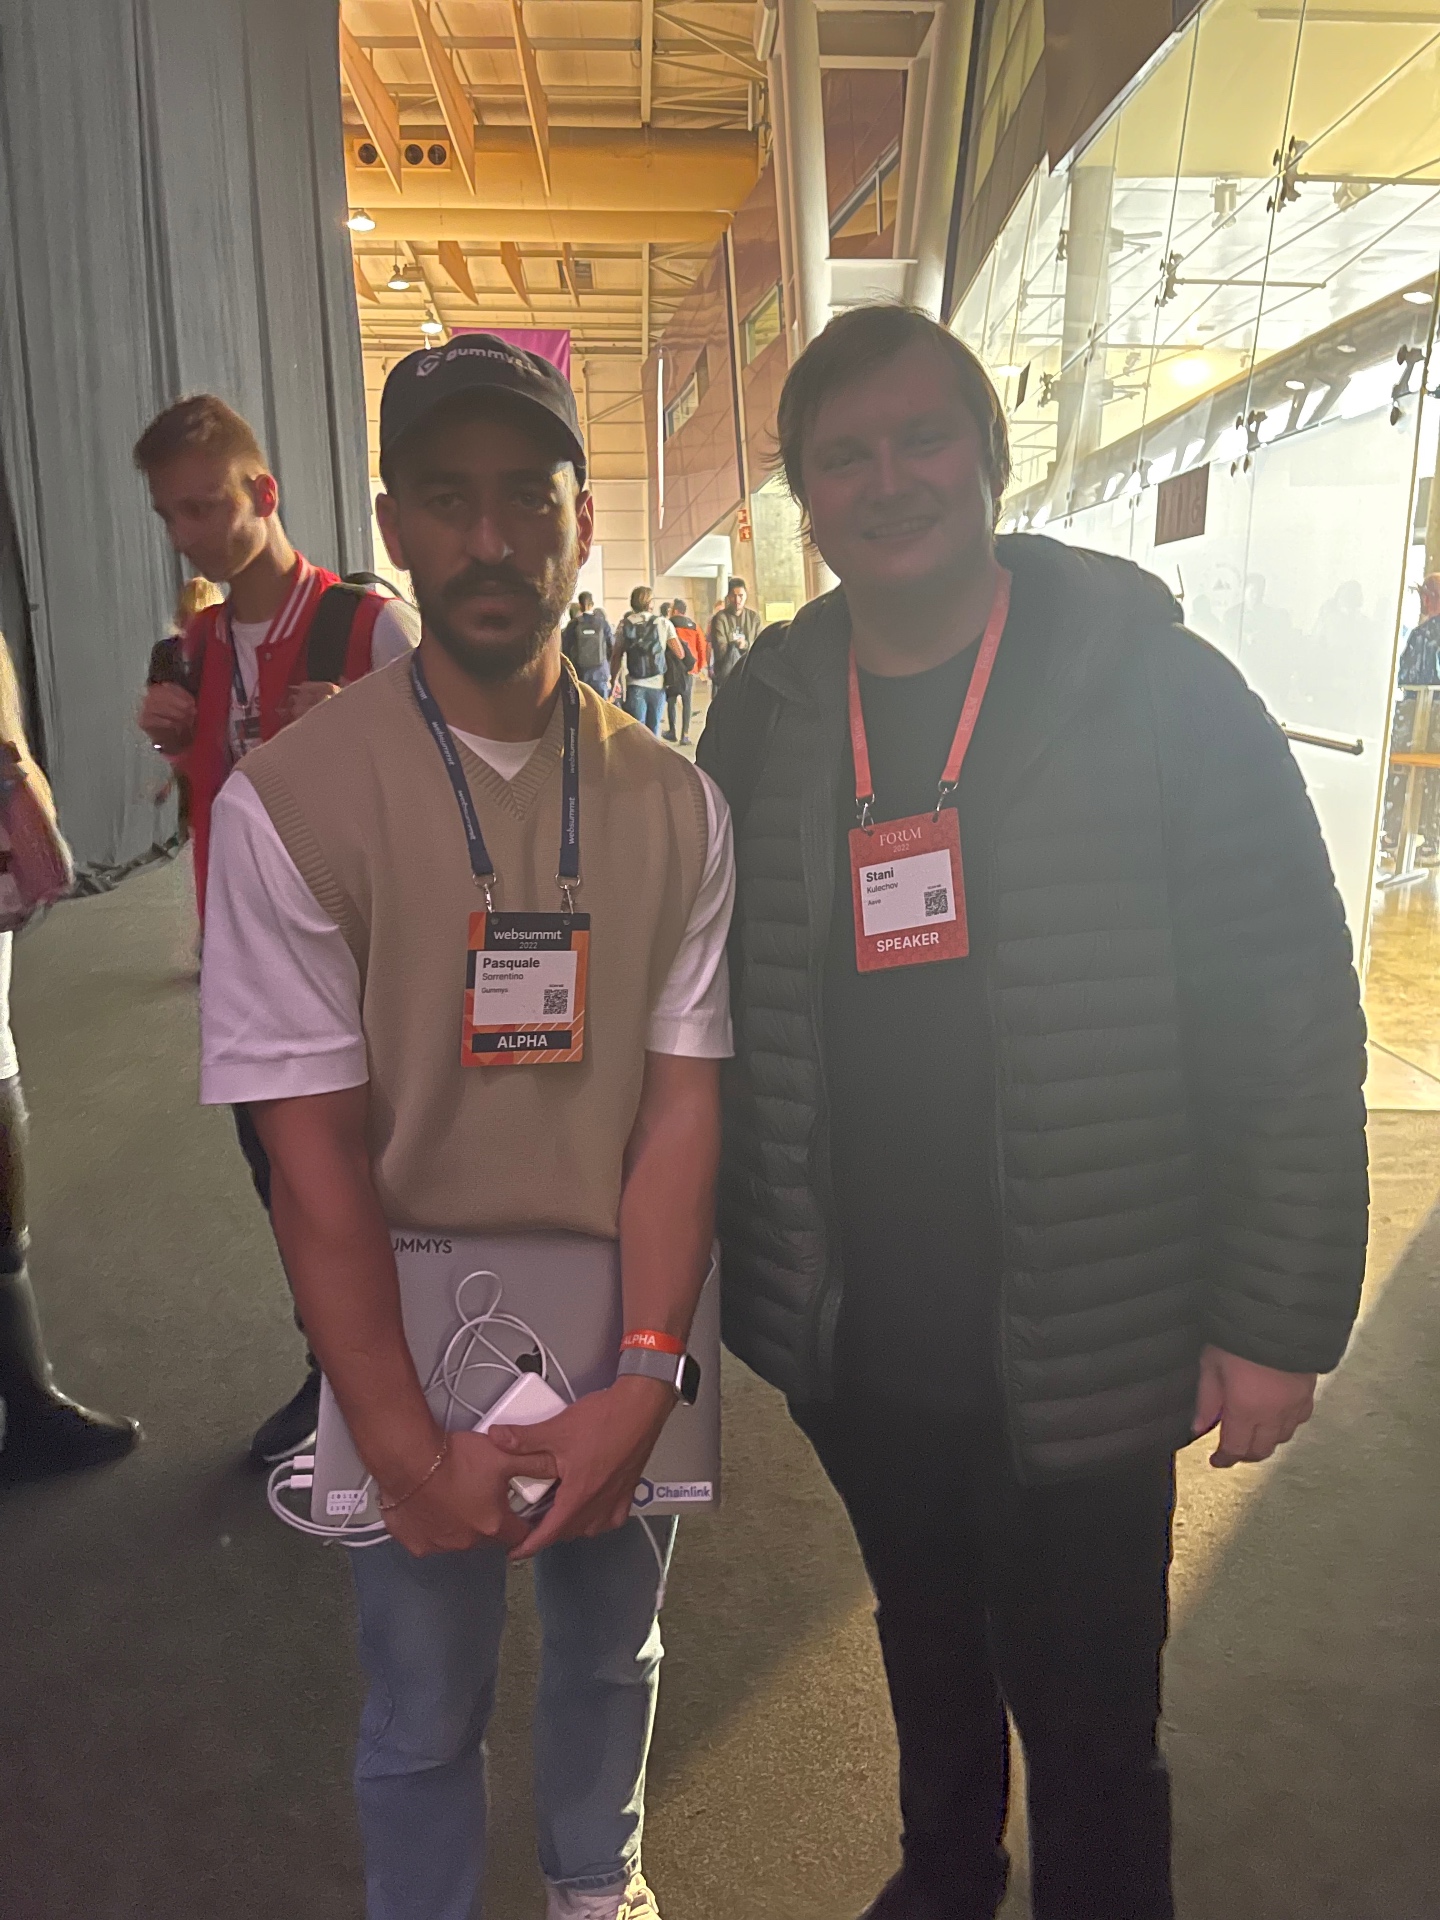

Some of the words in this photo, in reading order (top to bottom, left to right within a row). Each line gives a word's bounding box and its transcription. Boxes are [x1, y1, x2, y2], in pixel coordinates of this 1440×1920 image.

[568, 726, 577, 774] websummit
[567, 796, 577, 845] websummit
[879, 826, 922, 847] FORUM
[893, 843, 910, 853] 2022
[866, 867, 894, 883] Stani
[866, 881, 899, 894] Kulechov
[493, 928, 563, 940] websummit
[519, 942, 538, 950] 2022
[876, 931, 940, 953] SPEAKER
[482, 957, 541, 970] Pasquale
[482, 972, 524, 981] Sorrentino
[481, 987, 509, 995] Gummys
[497, 1035, 548, 1049] ALPHA
[622, 1333, 656, 1347] ALPHA
[656, 1485, 711, 1500] Chainlink
